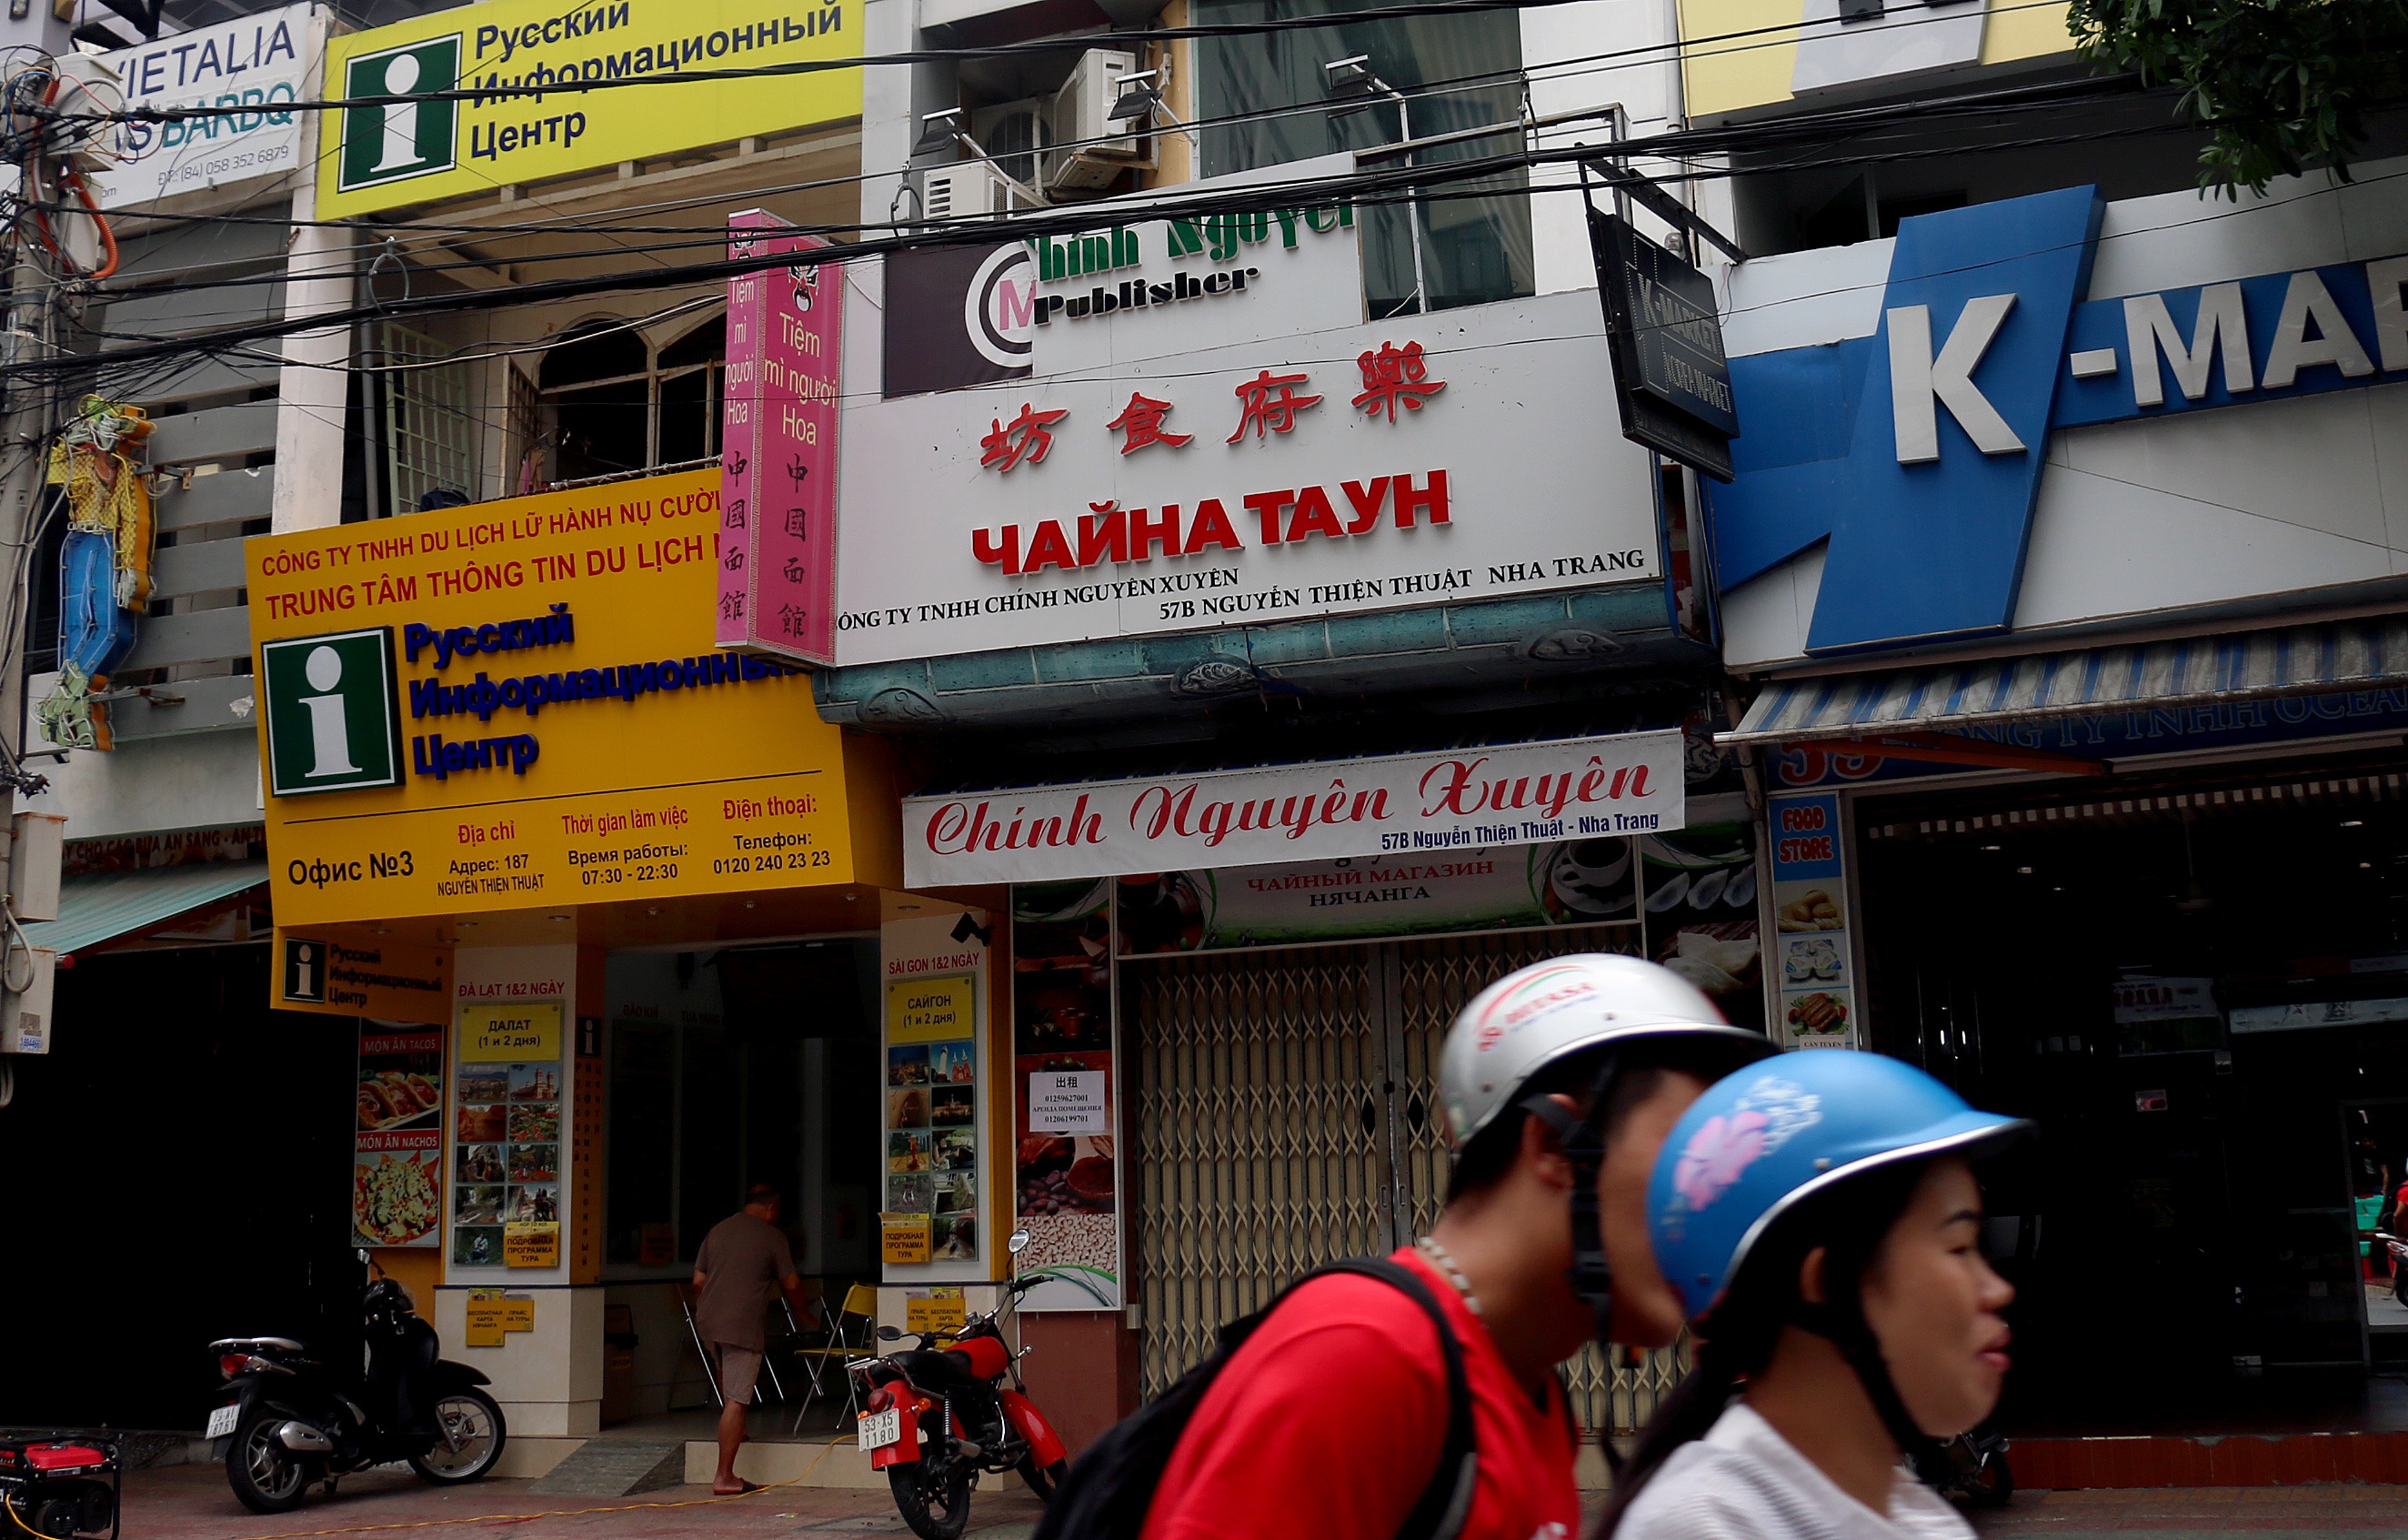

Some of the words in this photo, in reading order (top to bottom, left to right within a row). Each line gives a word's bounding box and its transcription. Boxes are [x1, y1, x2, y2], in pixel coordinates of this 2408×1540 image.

[476, 0, 630, 59] Русский
[473, 0, 844, 108] Информационный
[471, 110, 586, 161] Центр
[180, 163, 203, 183] (84)
[206, 158, 228, 175] 058
[233, 153, 254, 169] 352
[257, 145, 288, 163] 6879
[1033, 267, 1260, 326] Publisher
[779, 311, 821, 358] Tiệm
[764, 357, 785, 388] mì
[788, 369, 837, 409] người
[727, 397, 748, 426] Hoa
[782, 404, 818, 447] Hoa
[972, 499, 1247, 577] ЧАЙНА
[1243, 468, 1453, 546] ТАУН
[262, 549, 321, 578] CÔNG
[326, 546, 351, 568] TY
[356, 536, 414, 562] TNHH
[420, 529, 450, 554] DU
[456, 523, 505, 552] LỊCH
[512, 513, 544, 540] LỮ
[548, 502, 612, 536] HÀNH
[619, 499, 651, 528] NỤ
[266, 583, 356, 619] TRUNG
[361, 571, 417, 607] TÂM
[426, 560, 524, 598] THÔNG
[532, 552, 577, 585] TIN
[587, 546, 626, 578] DU
[637, 535, 704, 574] LỊCH
[1159, 600, 1196, 621] 57B
[1309, 579, 1383, 607] THIỆN
[1389, 568, 1473, 596] THUẬT
[1488, 560, 1546, 585] NHA
[1552, 549, 1645, 578] TRANG
[836, 609, 881, 633] ÔNG
[886, 606, 912, 628] TY
[918, 600, 980, 624] TNHH
[985, 587, 1059, 616] CHÍNH
[1064, 575, 1156, 605] NGUYÊN
[1159, 567, 1239, 596] XUYÊN
[404, 602, 576, 671] Русский
[408, 650, 794, 722] Информационны
[414, 732, 540, 782] Центр
[723, 799, 763, 822] Điện
[767, 793, 818, 818] thoại:
[926, 795, 1108, 857] Chính
[1129, 776, 1394, 847] Nguyên
[1419, 755, 1657, 820] Xuyên
[1781, 805, 1826, 831] FOOD
[457, 823, 486, 848] Địa
[489, 820, 516, 842] chỉ
[561, 812, 594, 836] Thời
[598, 813, 627, 838] gian
[631, 808, 657, 829] làm
[662, 806, 689, 831] việc
[1381, 833, 1409, 851] 57B
[1413, 825, 1470, 850] Nguyễn
[1475, 823, 1517, 846] Thiện
[1521, 819, 1564, 841] Thuật
[1579, 815, 1610, 834] Nha
[1614, 812, 1659, 830] Trang
[568, 849, 619, 868] Время
[623, 842, 689, 864] работы:
[733, 831, 813, 851] Телефон:
[1779, 835, 1834, 863] STORE
[287, 858, 363, 890] Офис
[368, 850, 415, 880] №3
[449, 860, 500, 876] Адрес:
[505, 853, 528, 870] 187
[582, 867, 622, 886] 07:30
[637, 863, 678, 881] 22:30
[713, 857, 750, 874] 0120
[755, 854, 783, 871] 240
[788, 852, 808, 869] 23
[811, 850, 831, 867] 23
[1248, 868, 1362, 891] ЧАЙНЫЙ
[1370, 861, 1494, 883] МАГАЗИН
[1309, 885, 1431, 907] НЯЧАНГА
[931, 956, 949, 970] 1&2
[951, 950, 979, 968] NGÀY
[328, 986, 367, 1008] Центр
[506, 982, 527, 997] 1&2
[531, 979, 565, 996] NGÀY
[908, 993, 951, 1010] САЙГОН
[488, 1020, 531, 1032] ДАЛАТ
[903, 1014, 912, 1029] (1
[915, 1016, 922, 1025] и
[925, 1012, 930, 1024] 2
[933, 1011, 957, 1025] дня)
[409, 1037, 436, 1050] TACOS
[478, 1035, 488, 1048] (1
[493, 1037, 501, 1046] и
[504, 1035, 511, 1046] 2
[514, 1035, 541, 1048] дня)
[1056, 1076, 1078, 1088] 出租
[402, 1135, 437, 1148] NACHOS
[885, 1232, 925, 1240] ПОДРОБНАЯ
[864, 1427, 895, 1448] 1180
